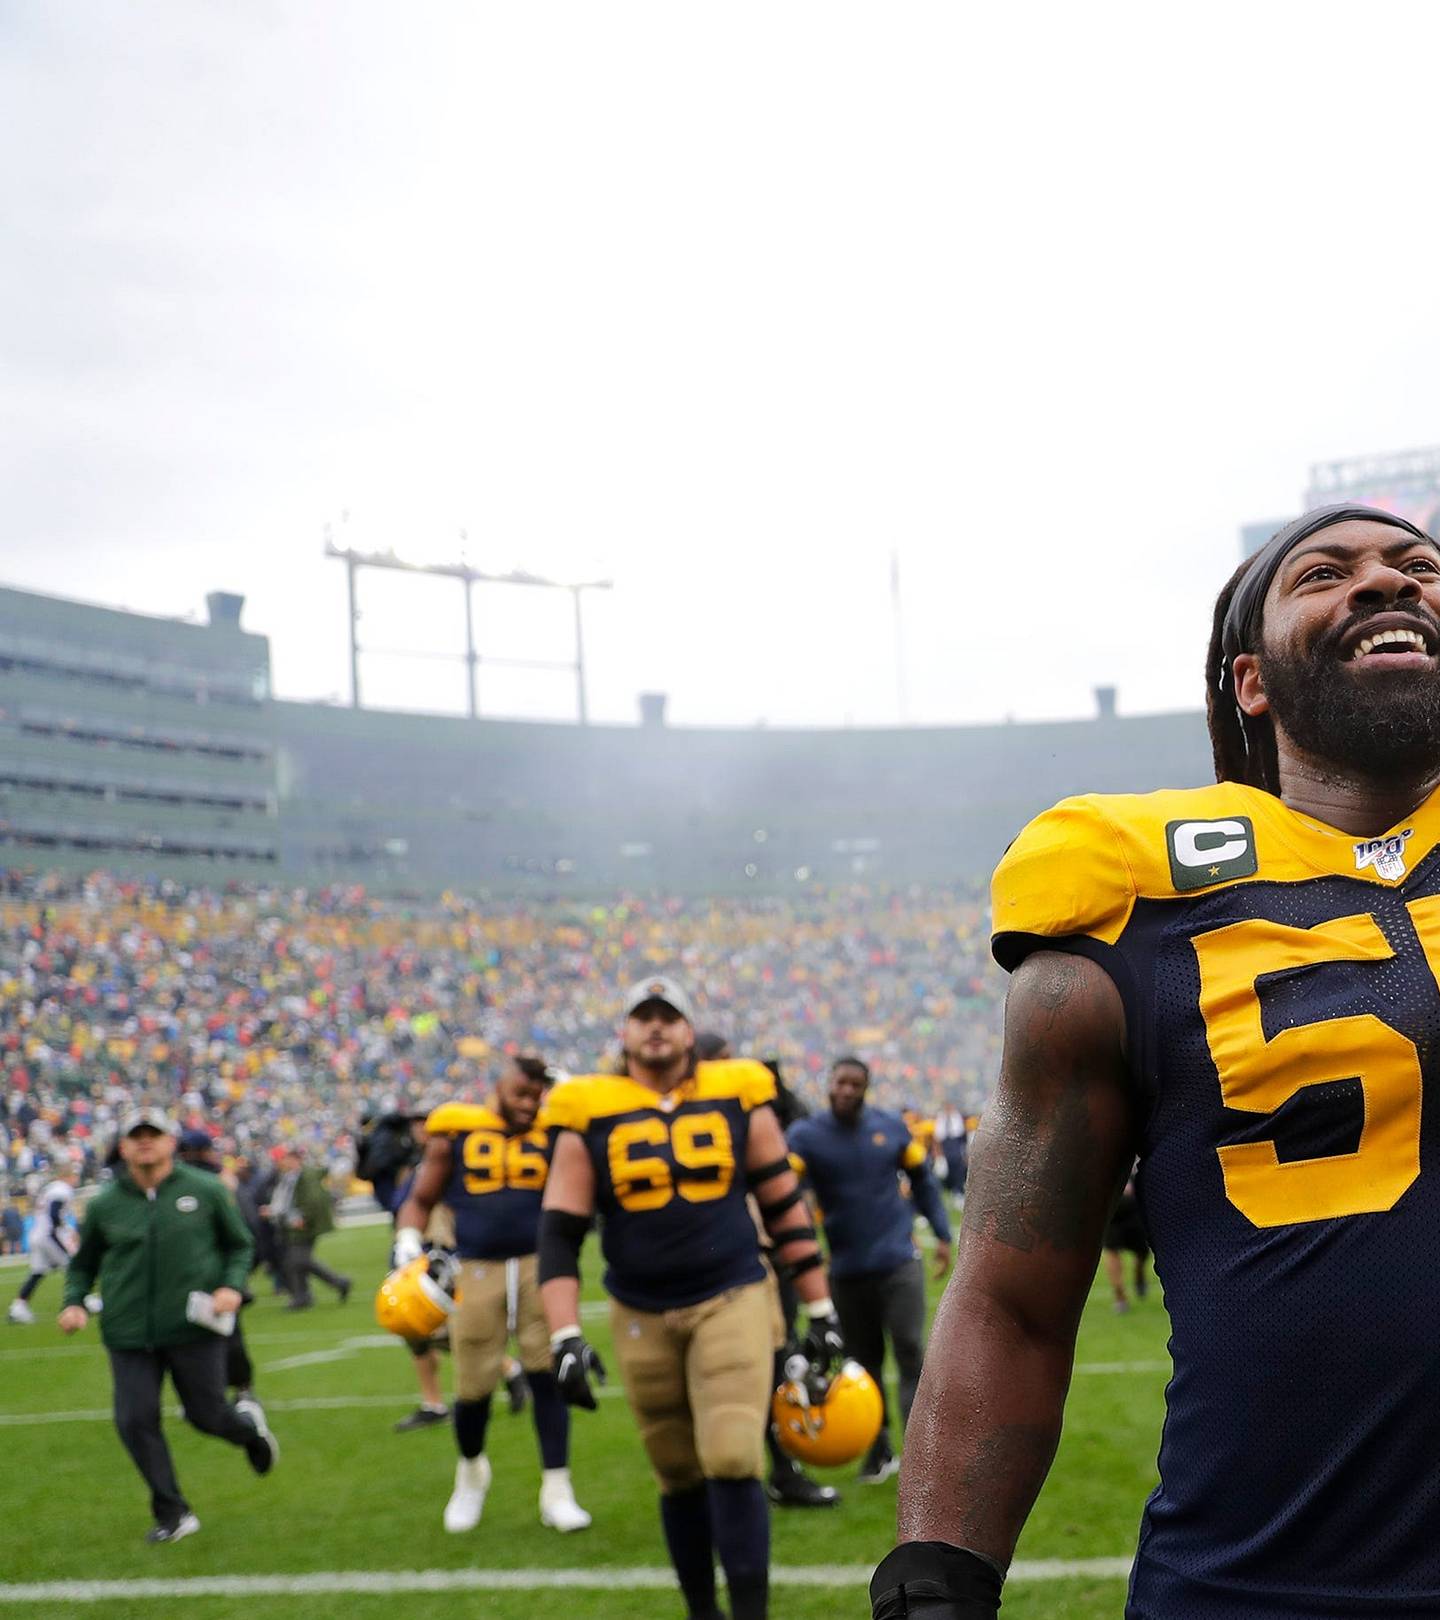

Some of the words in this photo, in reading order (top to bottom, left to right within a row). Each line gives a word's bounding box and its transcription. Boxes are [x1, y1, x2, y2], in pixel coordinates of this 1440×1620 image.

[1173, 820, 1248, 867] C
[462, 1129, 549, 1195] 96
[607, 1111, 736, 1212] 69
